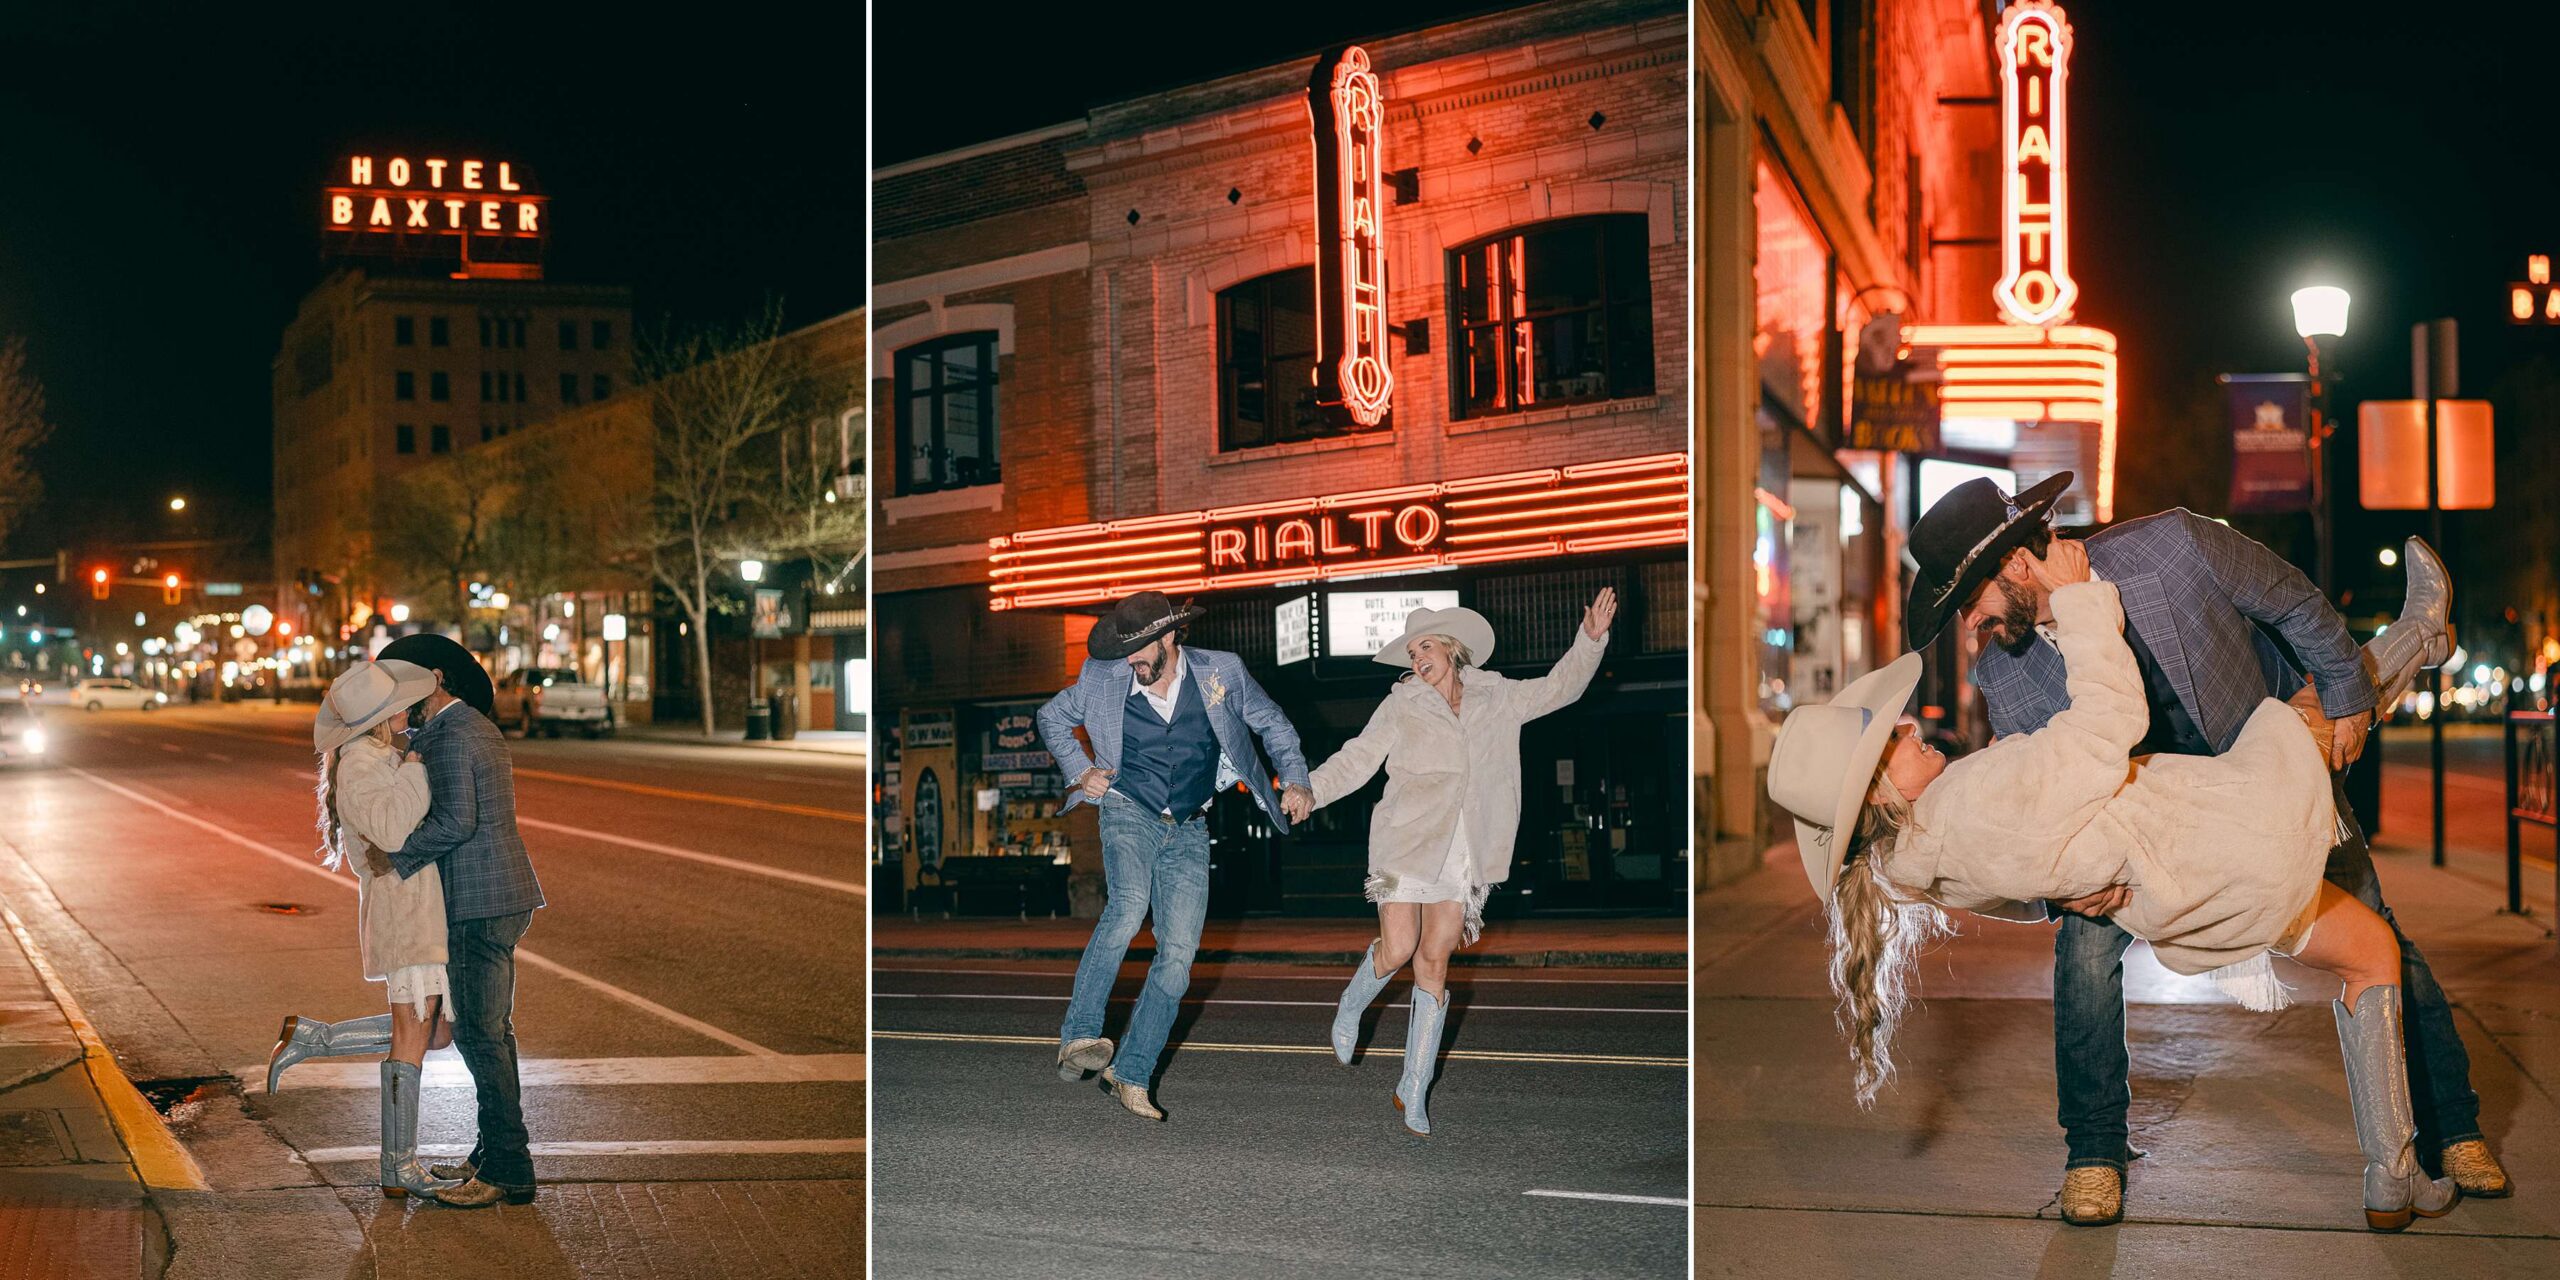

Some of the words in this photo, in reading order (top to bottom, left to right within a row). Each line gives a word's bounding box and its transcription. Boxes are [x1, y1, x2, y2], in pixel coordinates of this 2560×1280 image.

[351, 156, 521, 191] HOTEL
[2014, 24, 2056, 315] RIALTO
[332, 195, 539, 232] BAXTER
[1351, 86, 1381, 399] RIALTO
[1211, 504, 1440, 566] RIALTO
[1371, 611, 1409, 622] UPSTAIR
